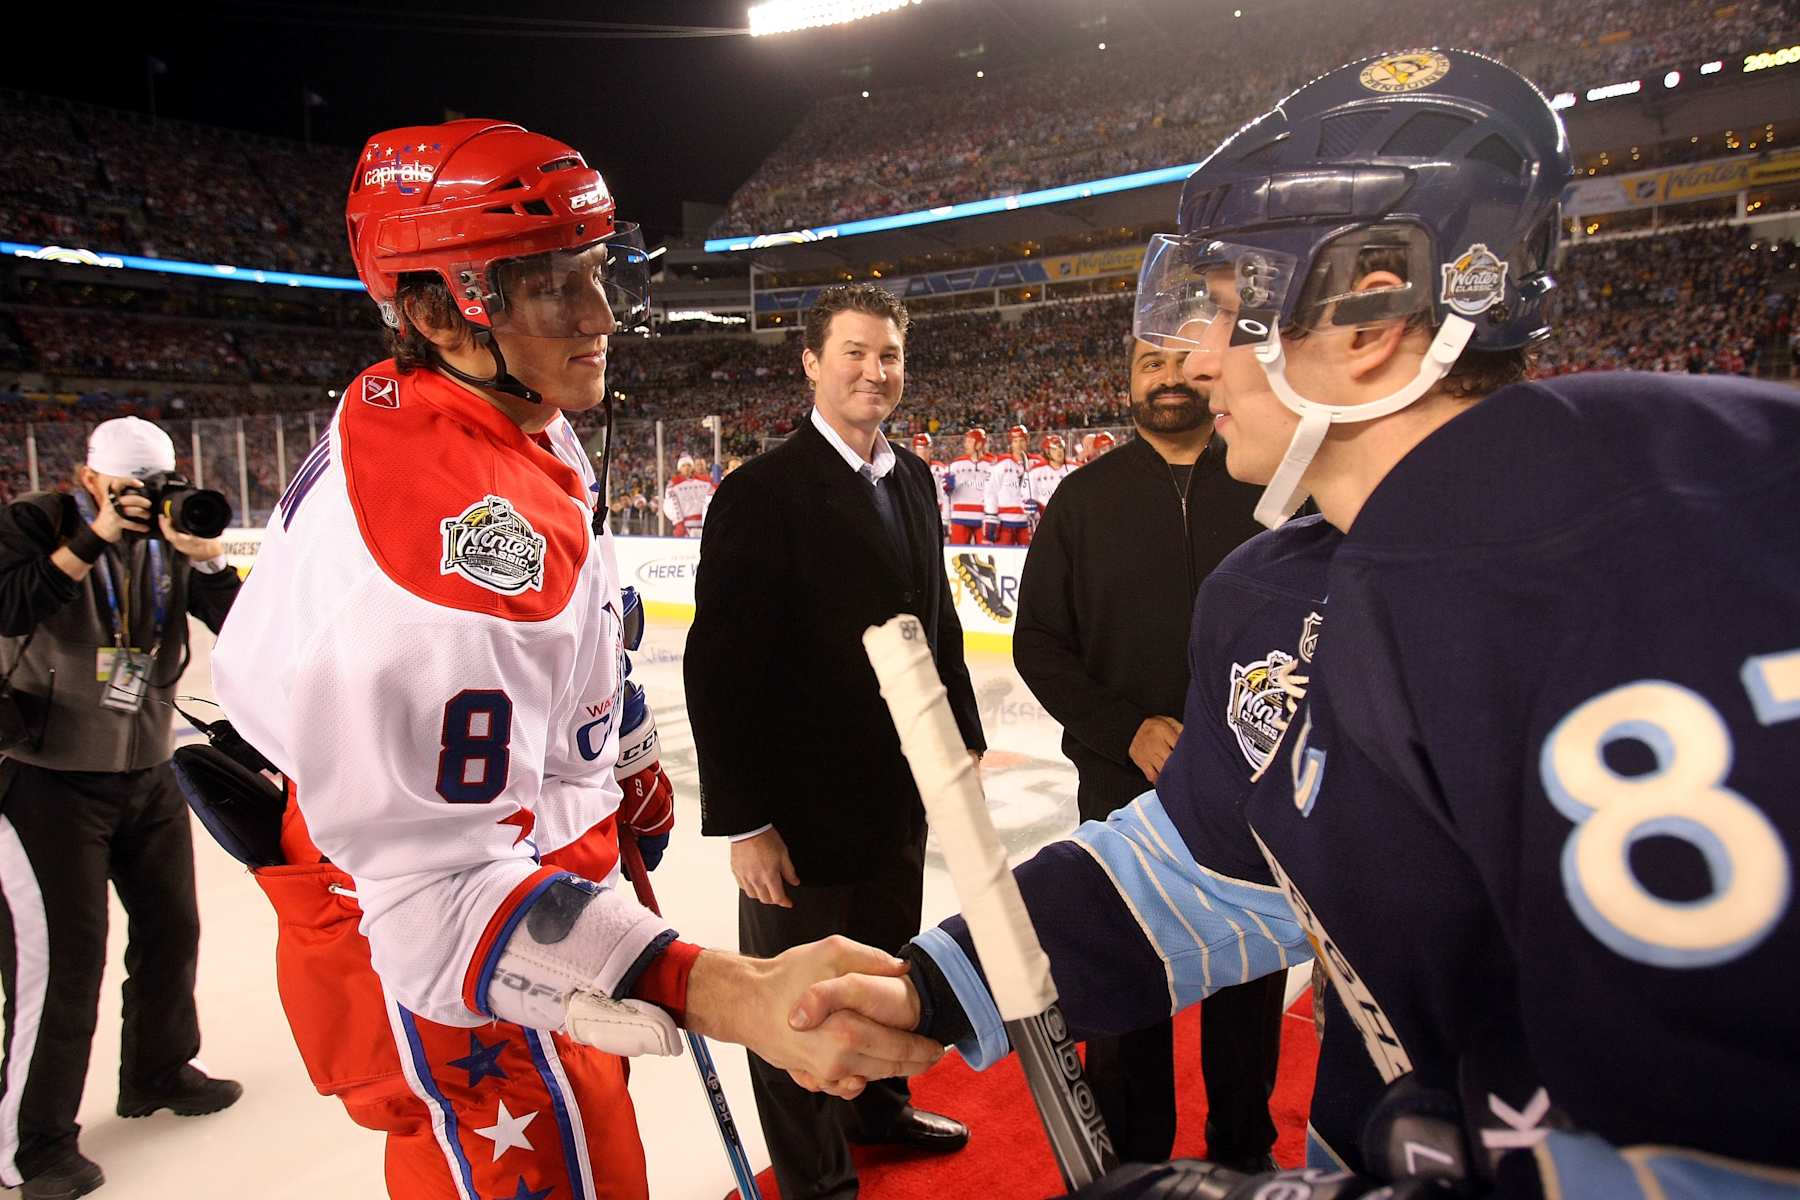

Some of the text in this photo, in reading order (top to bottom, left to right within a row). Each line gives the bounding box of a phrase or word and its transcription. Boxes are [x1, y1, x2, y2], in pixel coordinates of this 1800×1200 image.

[1450, 269, 1498, 293] Winter
[454, 522, 535, 561] Winter
[464, 545, 529, 568] CLASSIC
[648, 564, 686, 578] HERE
[899, 619, 918, 641] 87
[1242, 710, 1279, 740] CLASS
[435, 688, 513, 804] 8
[1044, 1004, 1115, 1168] ebok
